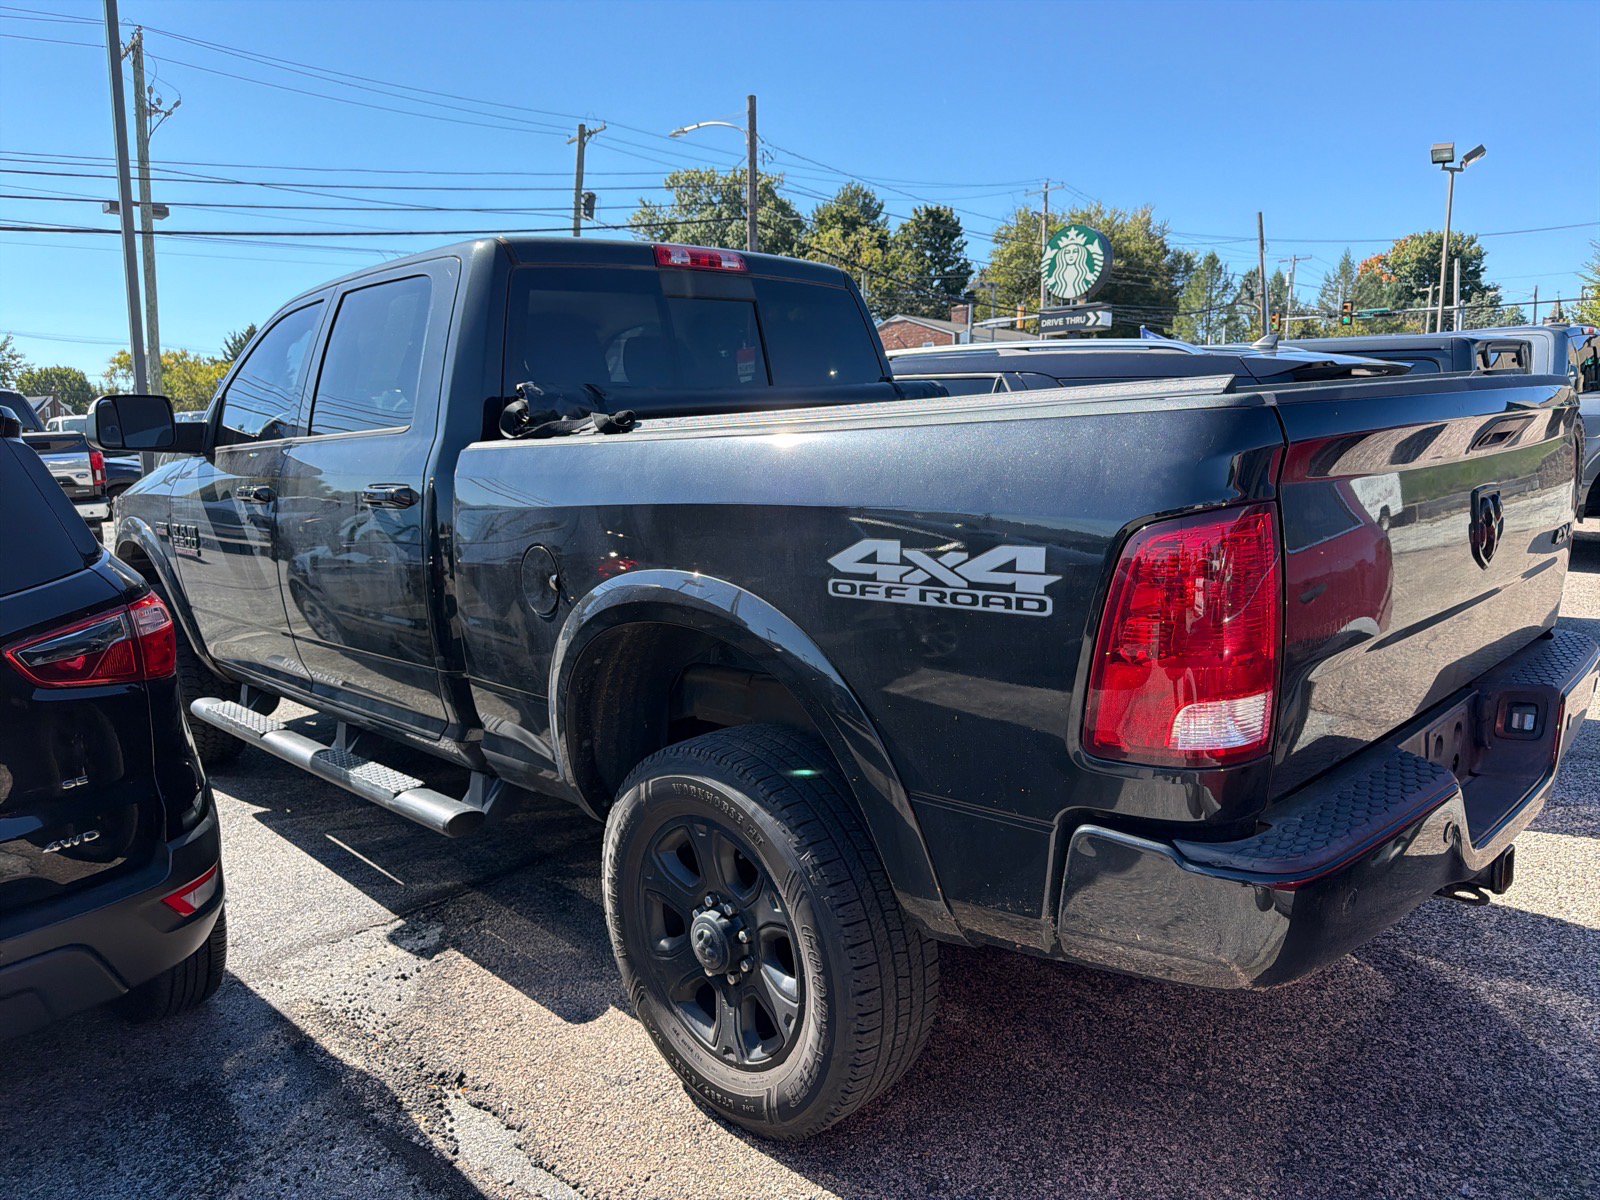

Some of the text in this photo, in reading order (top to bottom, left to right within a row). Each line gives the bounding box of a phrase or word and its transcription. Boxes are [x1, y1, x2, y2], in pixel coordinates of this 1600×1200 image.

[1041, 315, 1086, 327] DRIVE THRU
[171, 523, 197, 538] RAM
[827, 538, 1063, 594] 4X4
[831, 581, 1048, 613] OFF ROAD
[62, 775, 88, 790] SE
[42, 829, 101, 853] 4WD
